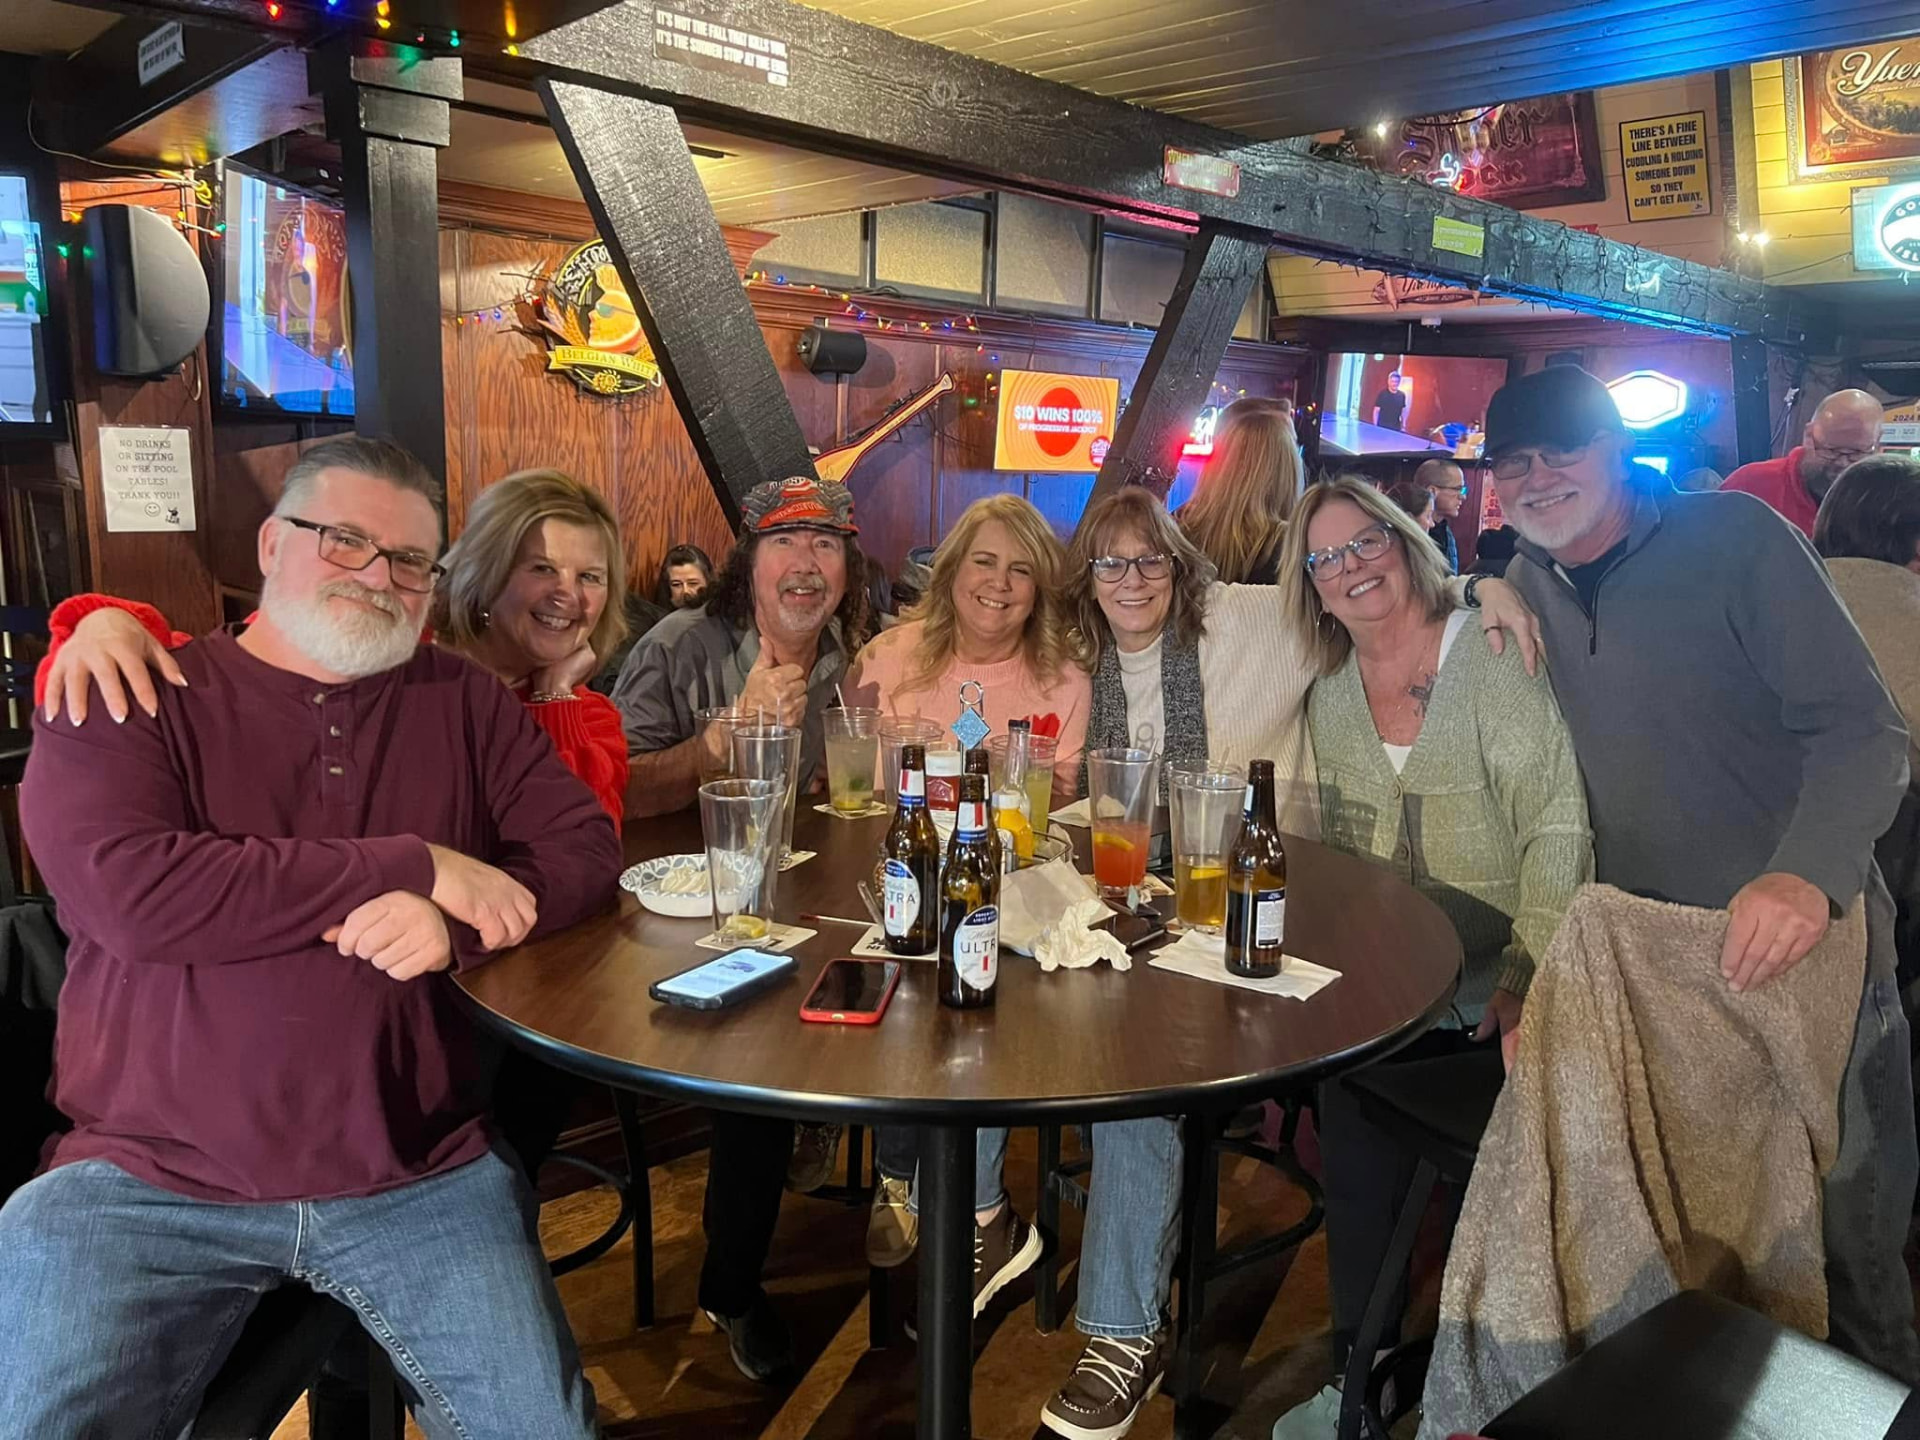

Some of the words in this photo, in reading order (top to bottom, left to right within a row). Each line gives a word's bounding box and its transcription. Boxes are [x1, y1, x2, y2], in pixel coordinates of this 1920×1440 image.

[656, 9, 673, 27] IT'S
[674, 14, 691, 32] NOT
[692, 18, 709, 37] THE
[709, 23, 728, 42] FALL
[656, 29, 673, 47] IT'S
[673, 33, 690, 51] THE
[1630, 126, 1665, 140] THERE'S
[1668, 124, 1674, 135] A
[1676, 120, 1697, 132] FINE
[1632, 140, 1652, 153] LINE
[1654, 134, 1696, 149] BETWEEN
[1626, 154, 1662, 168] CUDDLING
[1663, 153, 1669, 163] &
[1671, 149, 1703, 162] HOLDING
[1635, 167, 1671, 181] SOMEONE
[1672, 165, 1696, 177] DOWN
[1650, 184, 1661, 193] SO
[1664, 181, 1683, 191] THEY
[1634, 195, 1658, 207] CAN'T
[1660, 194, 1674, 205] GET
[1677, 192, 1703, 203] AWAY.
[562, 349, 616, 364] BELGIAN
[1014, 406, 1034, 419] $10
[1037, 407, 1070, 421] WINS
[1072, 409, 1102, 422] 100%
[136, 440, 171, 448] DRINKS
[119, 452, 131, 460] OR
[135, 453, 174, 461] SITTING
[132, 465, 150, 473] THE
[154, 465, 178, 473] POOL
[119, 491, 151, 499] THANK
[886, 890, 916, 904] TRA
